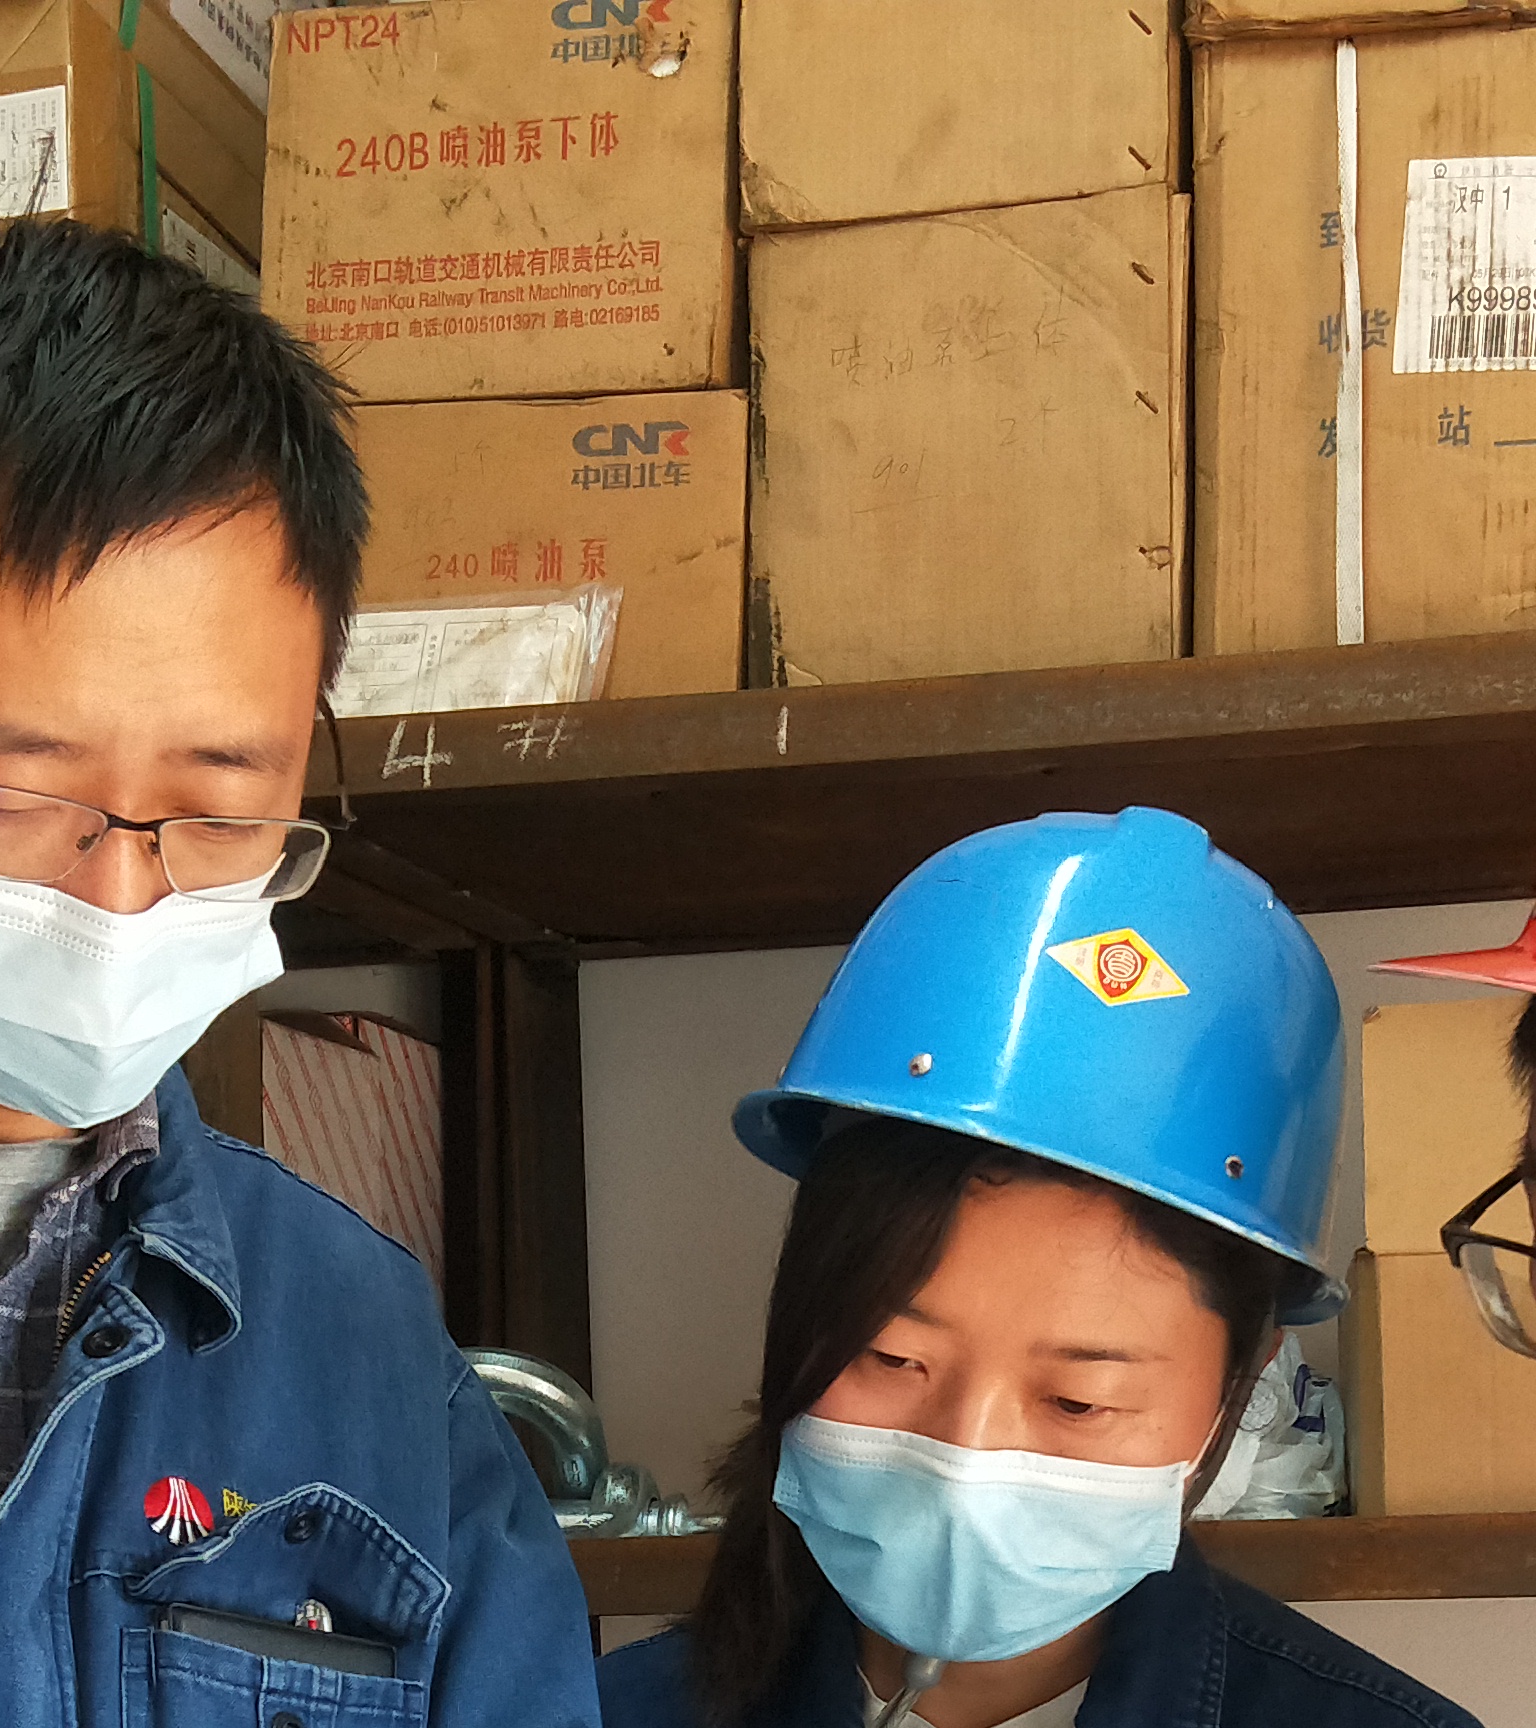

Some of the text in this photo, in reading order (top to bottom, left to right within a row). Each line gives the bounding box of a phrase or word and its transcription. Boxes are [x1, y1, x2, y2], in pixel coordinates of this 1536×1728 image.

[287, 12, 401, 54] NPT24
[305, 239, 661, 290] 北京南口轨道交通机械有限责任公司
[571, 420, 692, 458] CNR
[1435, 405, 1473, 449] 站
[570, 460, 692, 492] 中国北车
